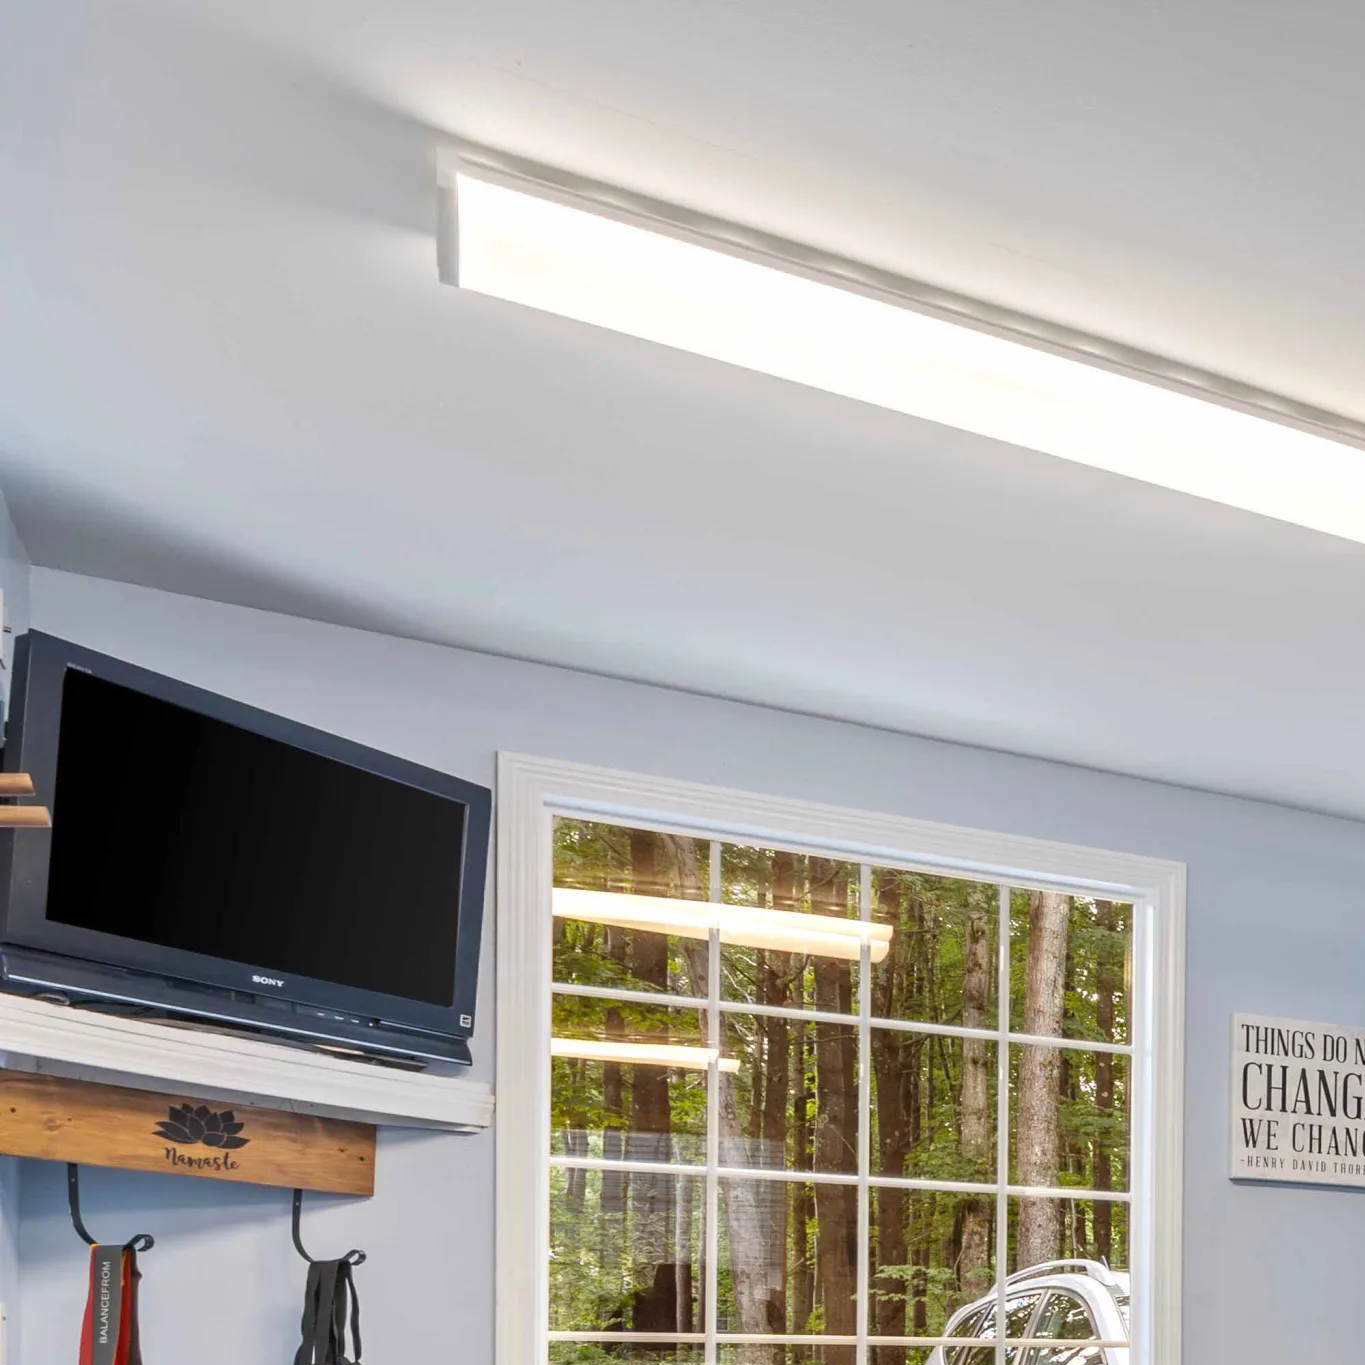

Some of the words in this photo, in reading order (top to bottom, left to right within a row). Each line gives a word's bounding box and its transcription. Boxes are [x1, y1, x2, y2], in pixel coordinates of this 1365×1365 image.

[252, 975, 284, 987] SONY
[1241, 1024, 1315, 1060] THINGS
[1322, 1034, 1348, 1063] DO
[1241, 1117, 1280, 1151] WE
[164, 1146, 241, 1171] Namaste
[1292, 1159, 1327, 1173] DAVID
[99, 1261, 111, 1344] BALANCEFROM
